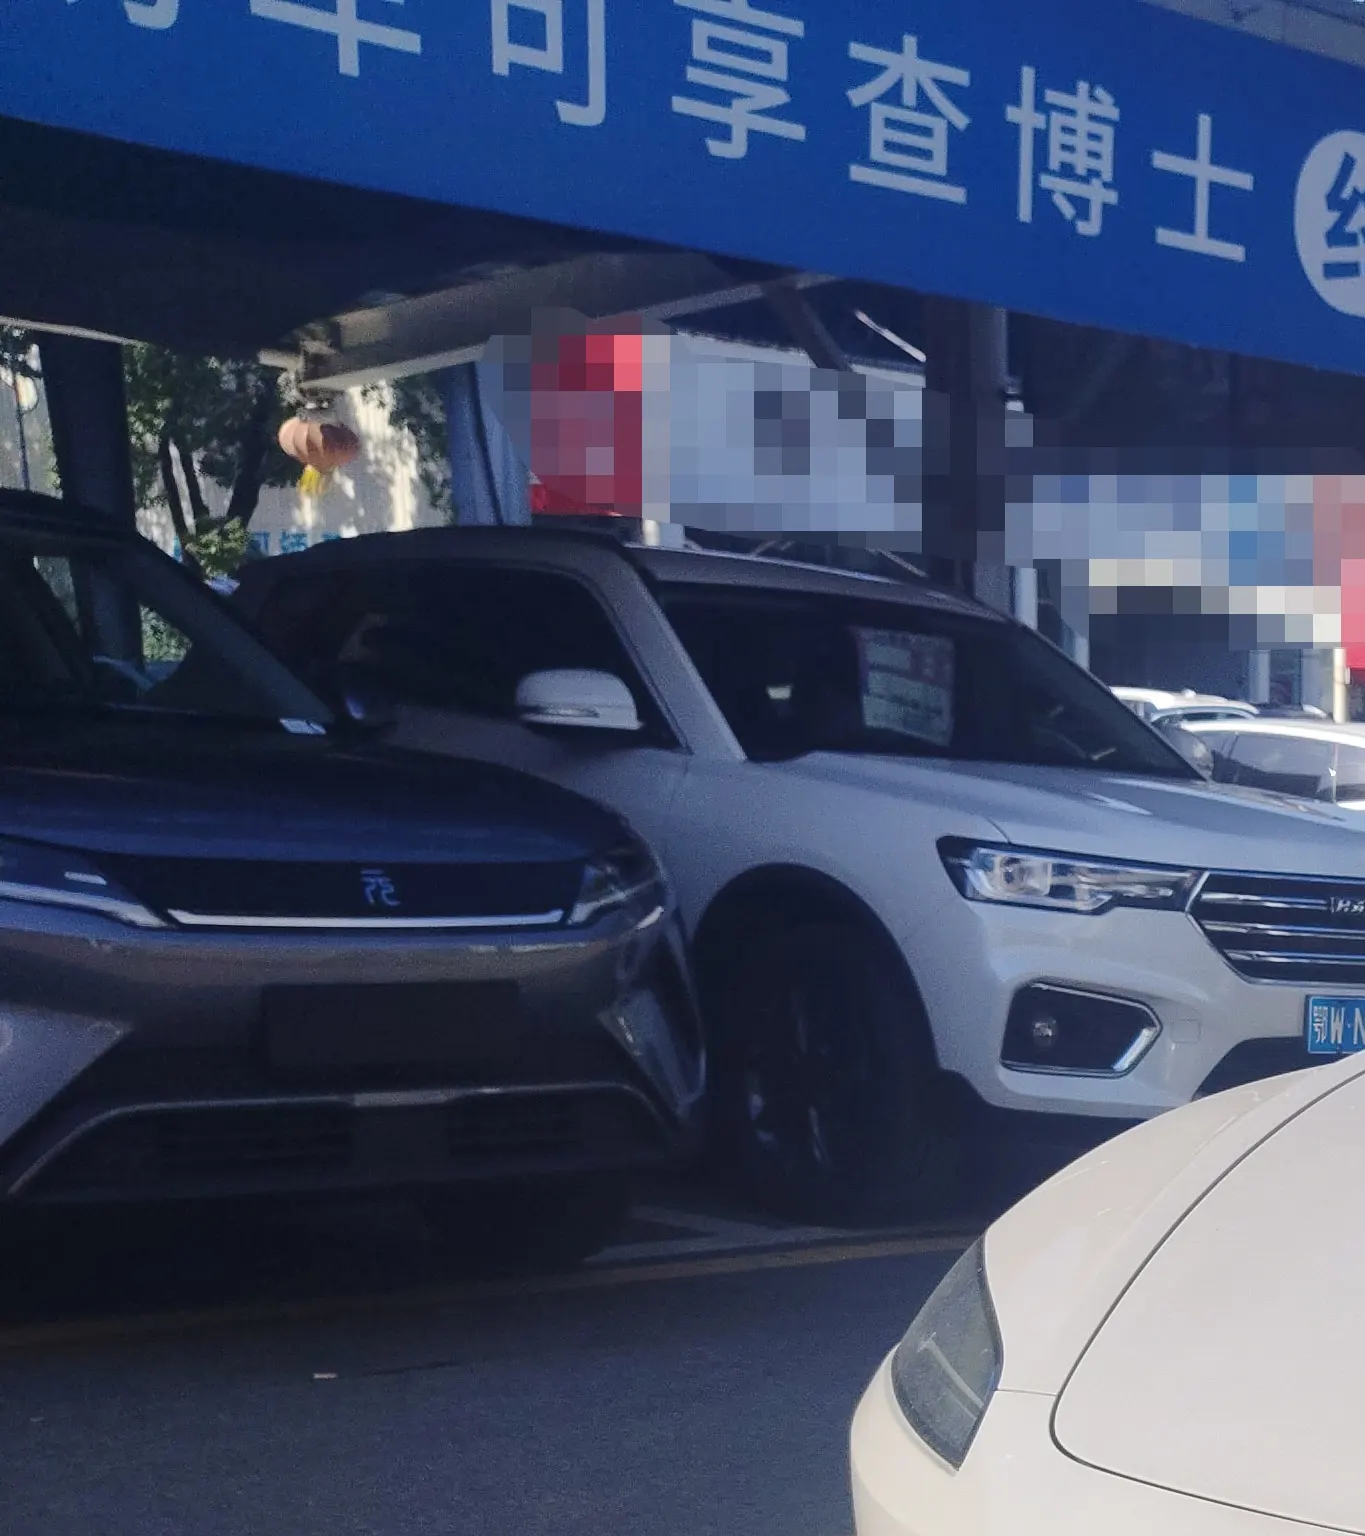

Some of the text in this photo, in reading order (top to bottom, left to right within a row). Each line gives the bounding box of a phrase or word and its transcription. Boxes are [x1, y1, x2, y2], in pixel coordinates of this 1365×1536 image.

[66, 0, 1253, 262] 可享查博士
